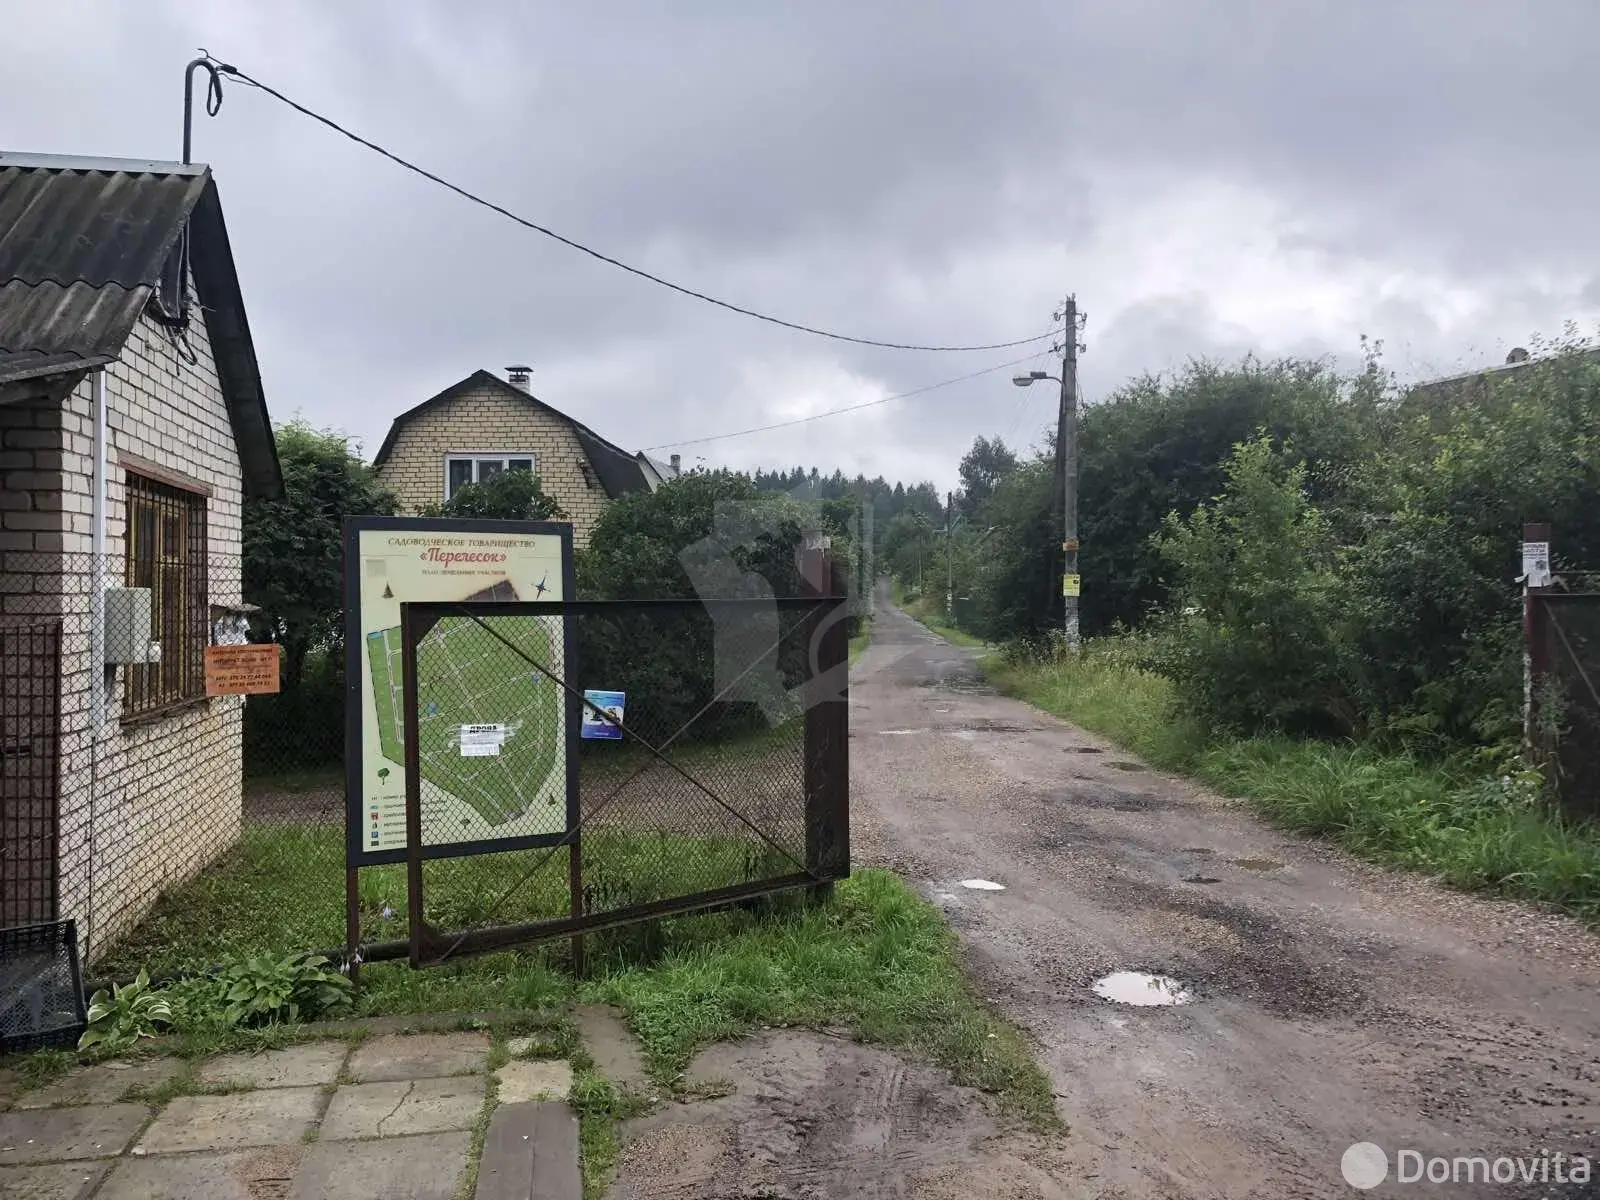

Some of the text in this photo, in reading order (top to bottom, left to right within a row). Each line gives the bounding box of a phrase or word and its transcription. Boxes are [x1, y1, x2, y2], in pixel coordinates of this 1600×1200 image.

[387, 537, 536, 548] САДОВОДЧЕСКОЕ ТОВАРИЩЕСТВО
[420, 547, 507, 568] «Перелесок»
